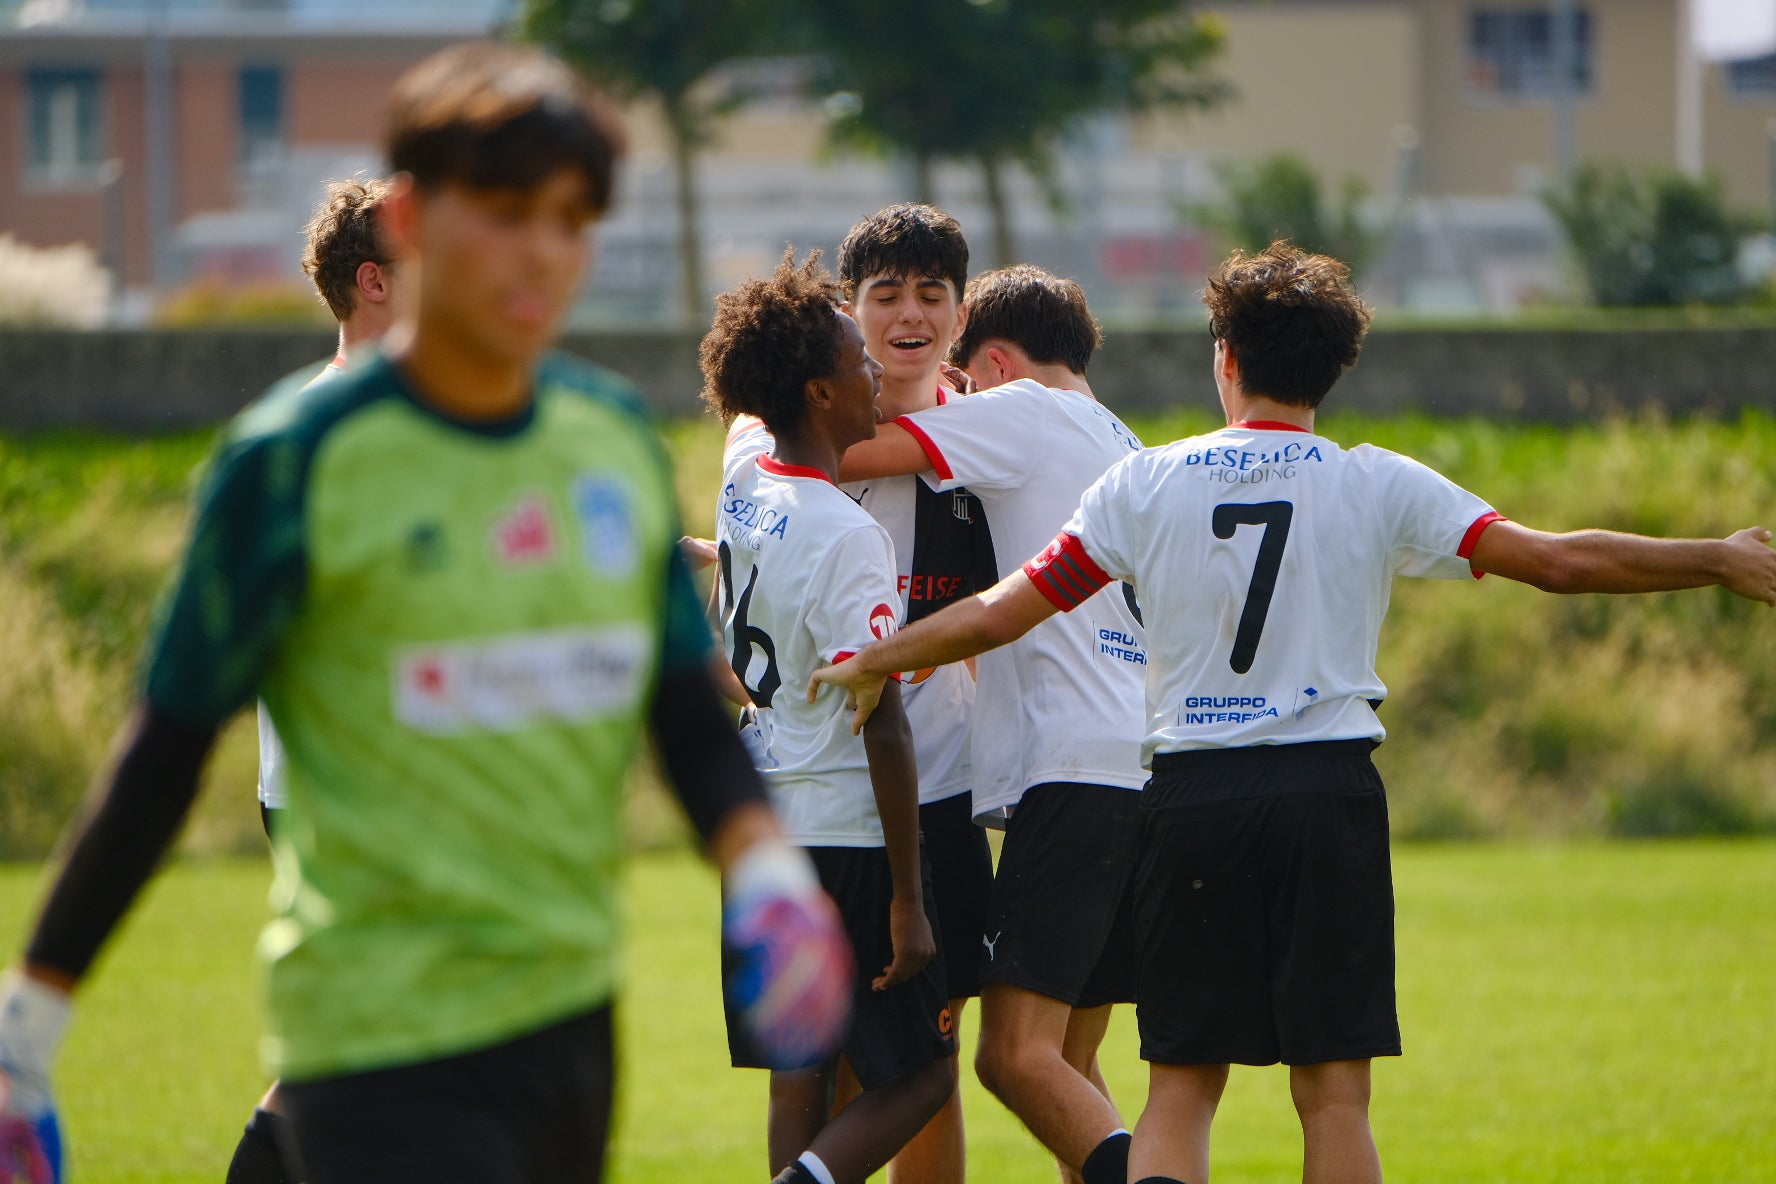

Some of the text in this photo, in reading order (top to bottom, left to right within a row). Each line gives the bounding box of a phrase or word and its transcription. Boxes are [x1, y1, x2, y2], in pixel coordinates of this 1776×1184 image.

[1209, 465, 1297, 484] HOLDING
[1212, 500, 1294, 675] 7
[1099, 629, 1138, 647] GRU
[1185, 697, 1267, 709] GRUPPO
[1185, 707, 1279, 724] INTERFIDA
